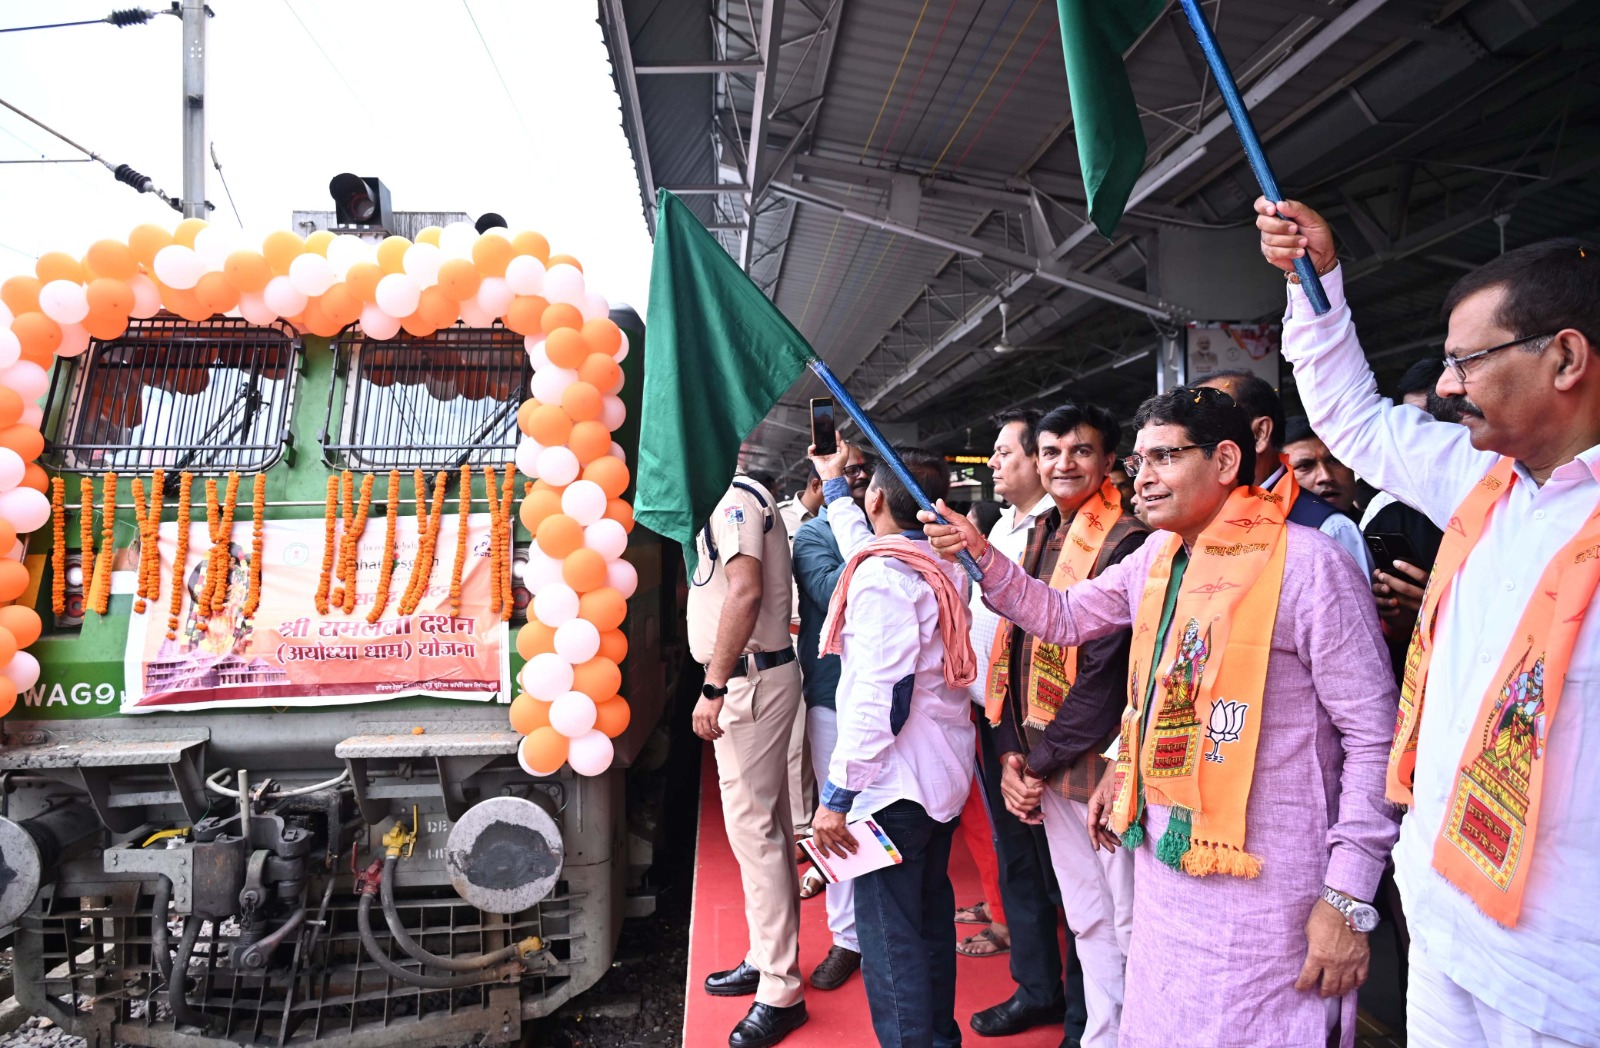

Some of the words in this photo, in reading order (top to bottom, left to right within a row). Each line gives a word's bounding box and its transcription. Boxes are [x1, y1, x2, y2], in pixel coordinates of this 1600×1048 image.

[1226, 542, 1242, 556] श्री
[279, 617, 311, 638] श्री
[319, 615, 414, 637] रामलला
[277, 641, 357, 664] (अयोध्या
[364, 640, 413, 661] धाम)
[418, 637, 476, 658] योजना
